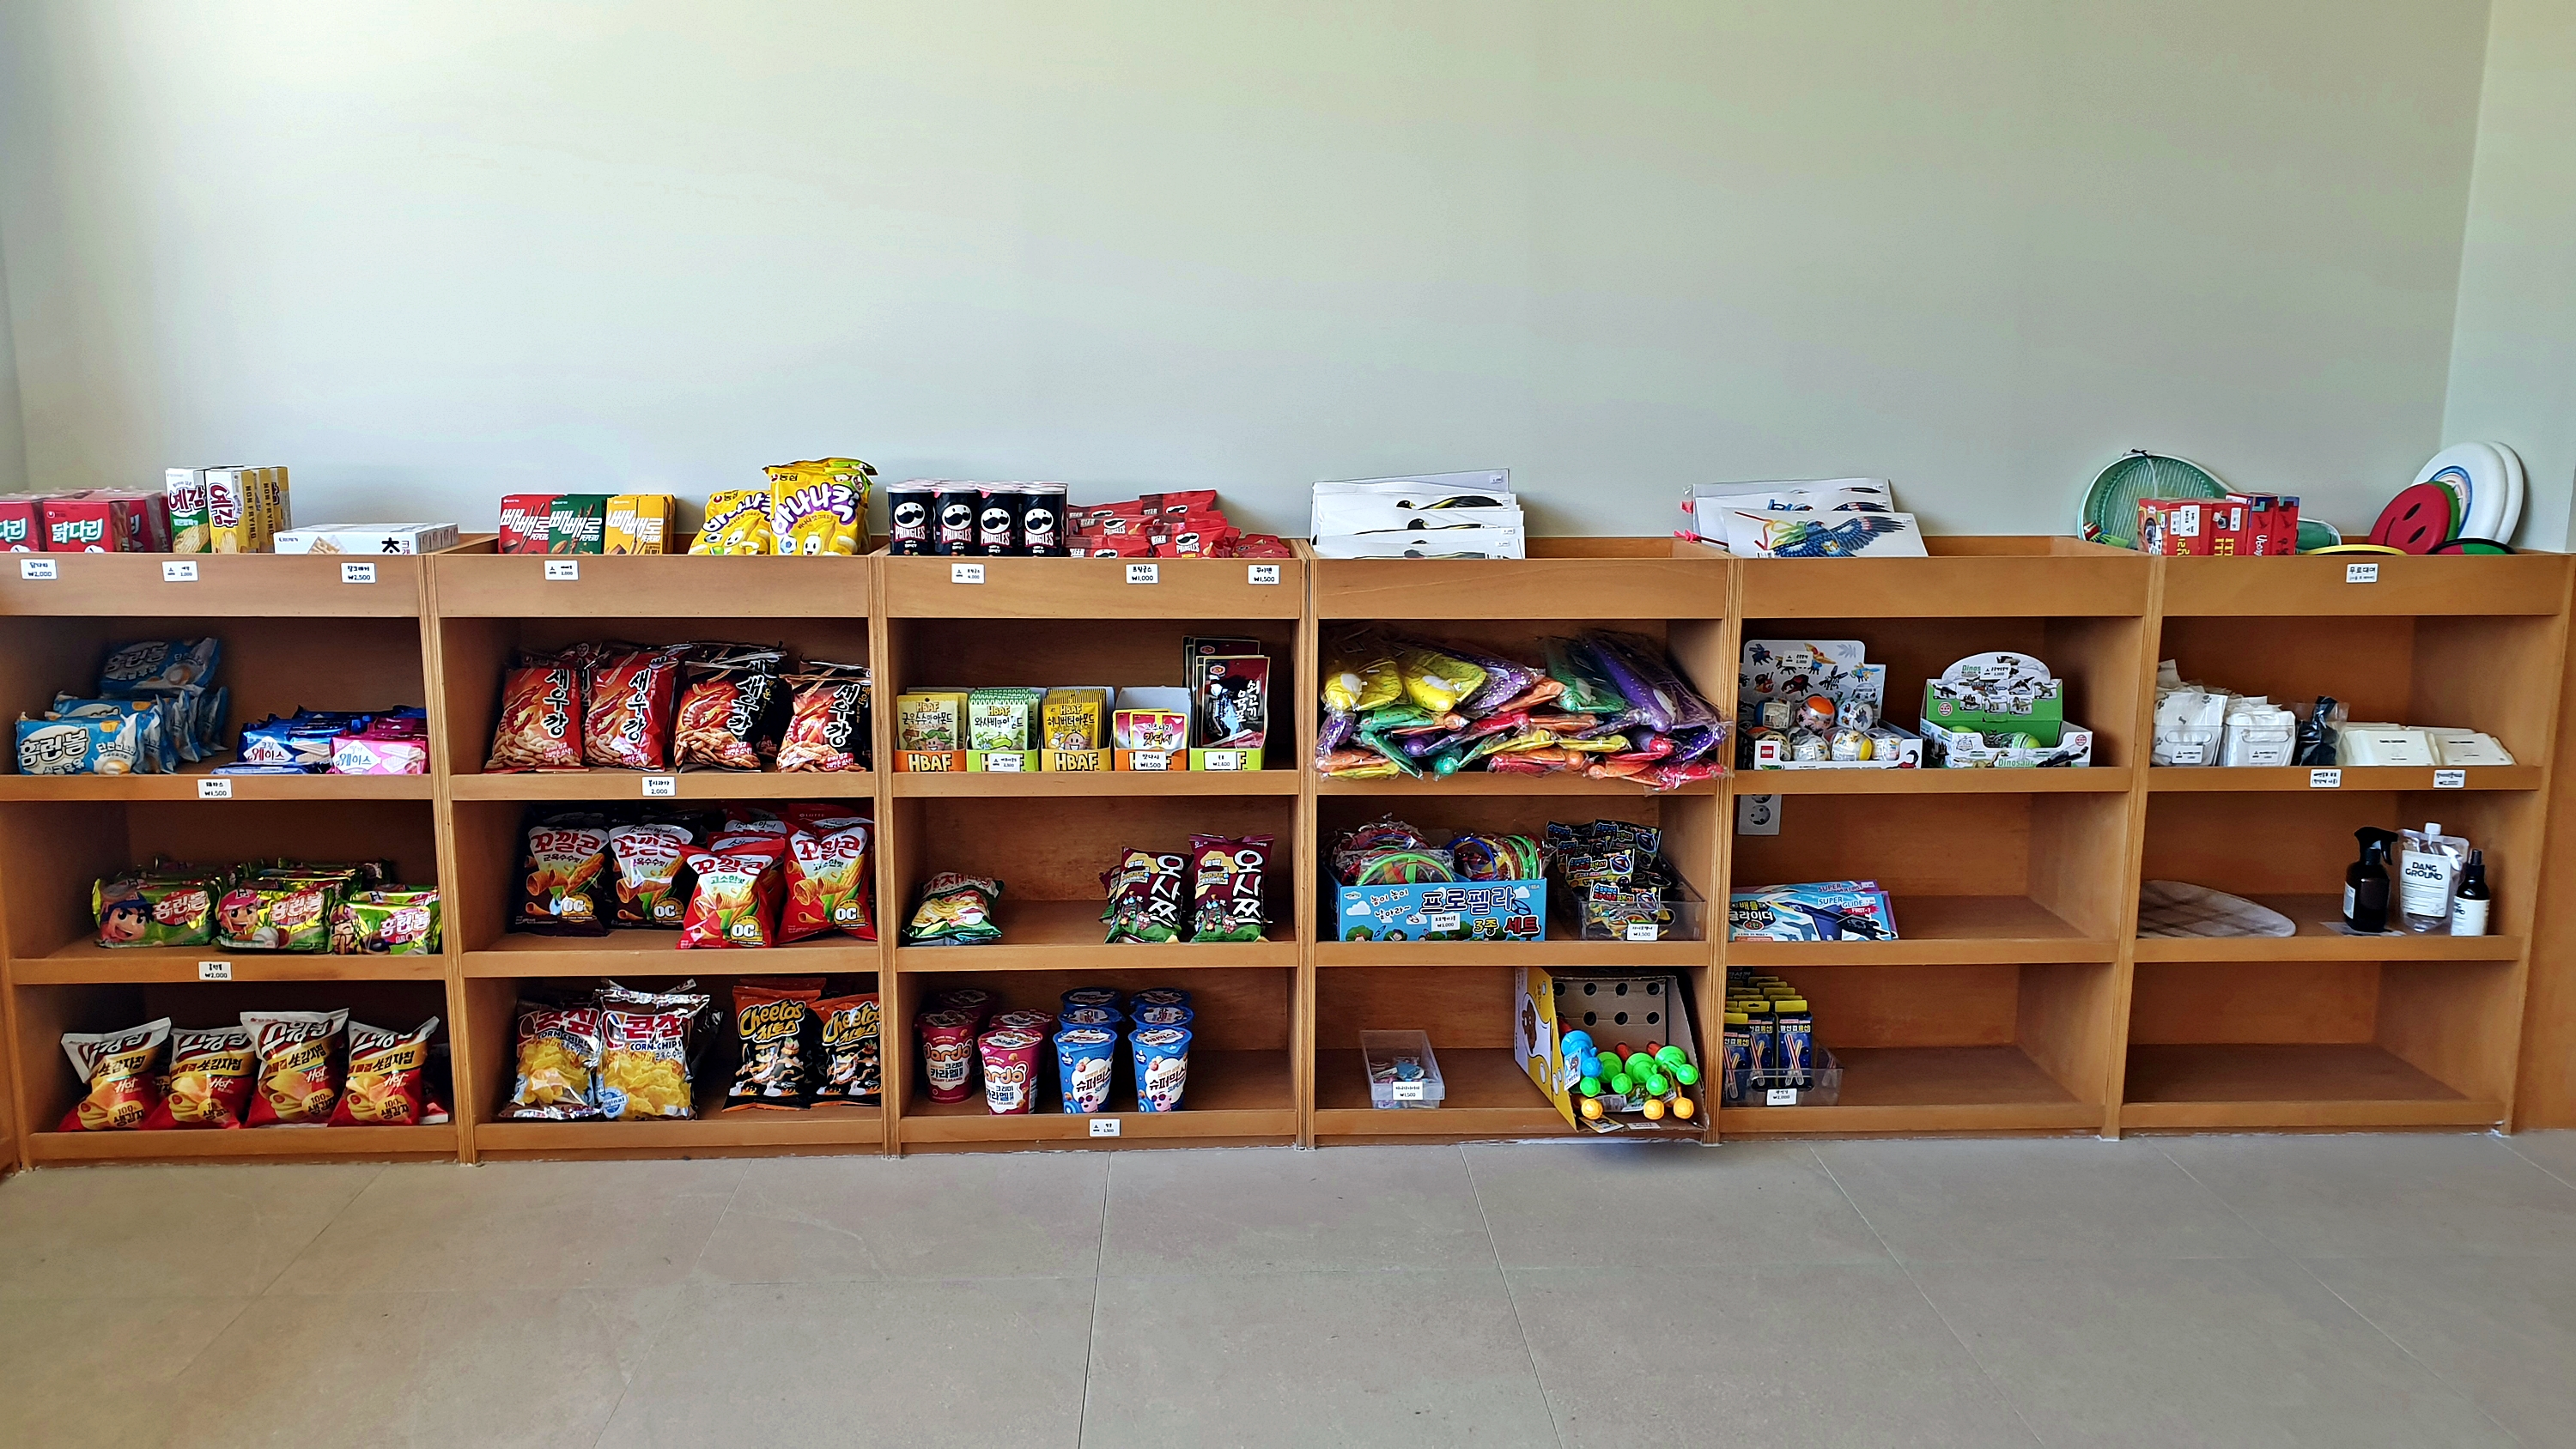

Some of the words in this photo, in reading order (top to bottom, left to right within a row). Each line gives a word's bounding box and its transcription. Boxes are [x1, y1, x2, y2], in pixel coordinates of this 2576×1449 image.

[780, 473, 799, 482] 농심
[168, 485, 206, 512] 예감
[209, 482, 238, 527] 예감
[771, 482, 854, 535] 바나나킥
[702, 492, 771, 532] 바나나
[52, 518, 104, 544] 닭다리
[500, 509, 550, 536] 빼빼로
[550, 511, 603, 538] 빼빼로
[607, 510, 664, 538] 빼빼로
[895, 525, 926, 541] PRINGLES
[942, 526, 972, 543] PRINGLES
[981, 530, 1011, 546] PRINGLES
[1025, 530, 1054, 547] PRINGLES
[1176, 543, 1200, 555] PRINGLES
[541, 670, 570, 739] 새우깡
[621, 668, 651, 743] 새우깡
[726, 675, 765, 736] 새우깡
[916, 701, 939, 714] HBAF
[1247, 679, 1260, 718] 쇠고기
[823, 683, 860, 748] 새우깡
[987, 706, 1011, 716] HBAF
[1060, 704, 1082, 715] HBAF
[20, 729, 88, 767] 홈런볼
[1143, 732, 1173, 746] 맛다시
[908, 753, 952, 772] HBAF
[1054, 752, 1098, 771] HBAF
[1999, 758, 2034, 767] Dinosaur
[531, 831, 601, 857] 꼬깔콘
[613, 833, 683, 858] 꼬깔콘
[796, 834, 861, 862] 꼬깔콘
[691, 857, 766, 877] 꼬깔콘
[2405, 868, 2443, 881] GROUND
[2412, 861, 2437, 872] DANG
[1148, 854, 1184, 928] 오사쯔
[1232, 849, 1264, 925] 오사쯔
[1370, 894, 1389, 906] 높이
[1390, 888, 1409, 899] 높이
[1818, 882, 1842, 893] SUPER
[152, 891, 208, 921] 홈런볼
[270, 894, 324, 921] 홈런볼
[1419, 886, 1516, 916] 프로펠라
[1819, 896, 1844, 906] SUPER
[1842, 900, 1866, 908] GLIDE
[380, 909, 430, 937] 홈런볼
[1473, 918, 1498, 935] 3종
[1504, 915, 1541, 936] 세트
[1728, 911, 1773, 922] 글라이더
[529, 1007, 599, 1040] 콘칩
[617, 1013, 691, 1043] 콘칩
[738, 1000, 805, 1038] Cheetos
[261, 1020, 331, 1058] 스윙칩
[538, 1029, 561, 1040] CORN
[562, 1033, 589, 1047] CHIPS
[756, 1022, 797, 1041] 치토스
[838, 1023, 878, 1044] 치토스
[630, 1043, 653, 1052] CORN
[655, 1040, 682, 1050] CHIPS
[306, 1066, 328, 1082] Hot
[384, 1073, 409, 1087] Hot
[115, 1078, 137, 1094] Hot
[209, 1078, 235, 1092] Hot
[380, 1105, 410, 1119] 생감자
